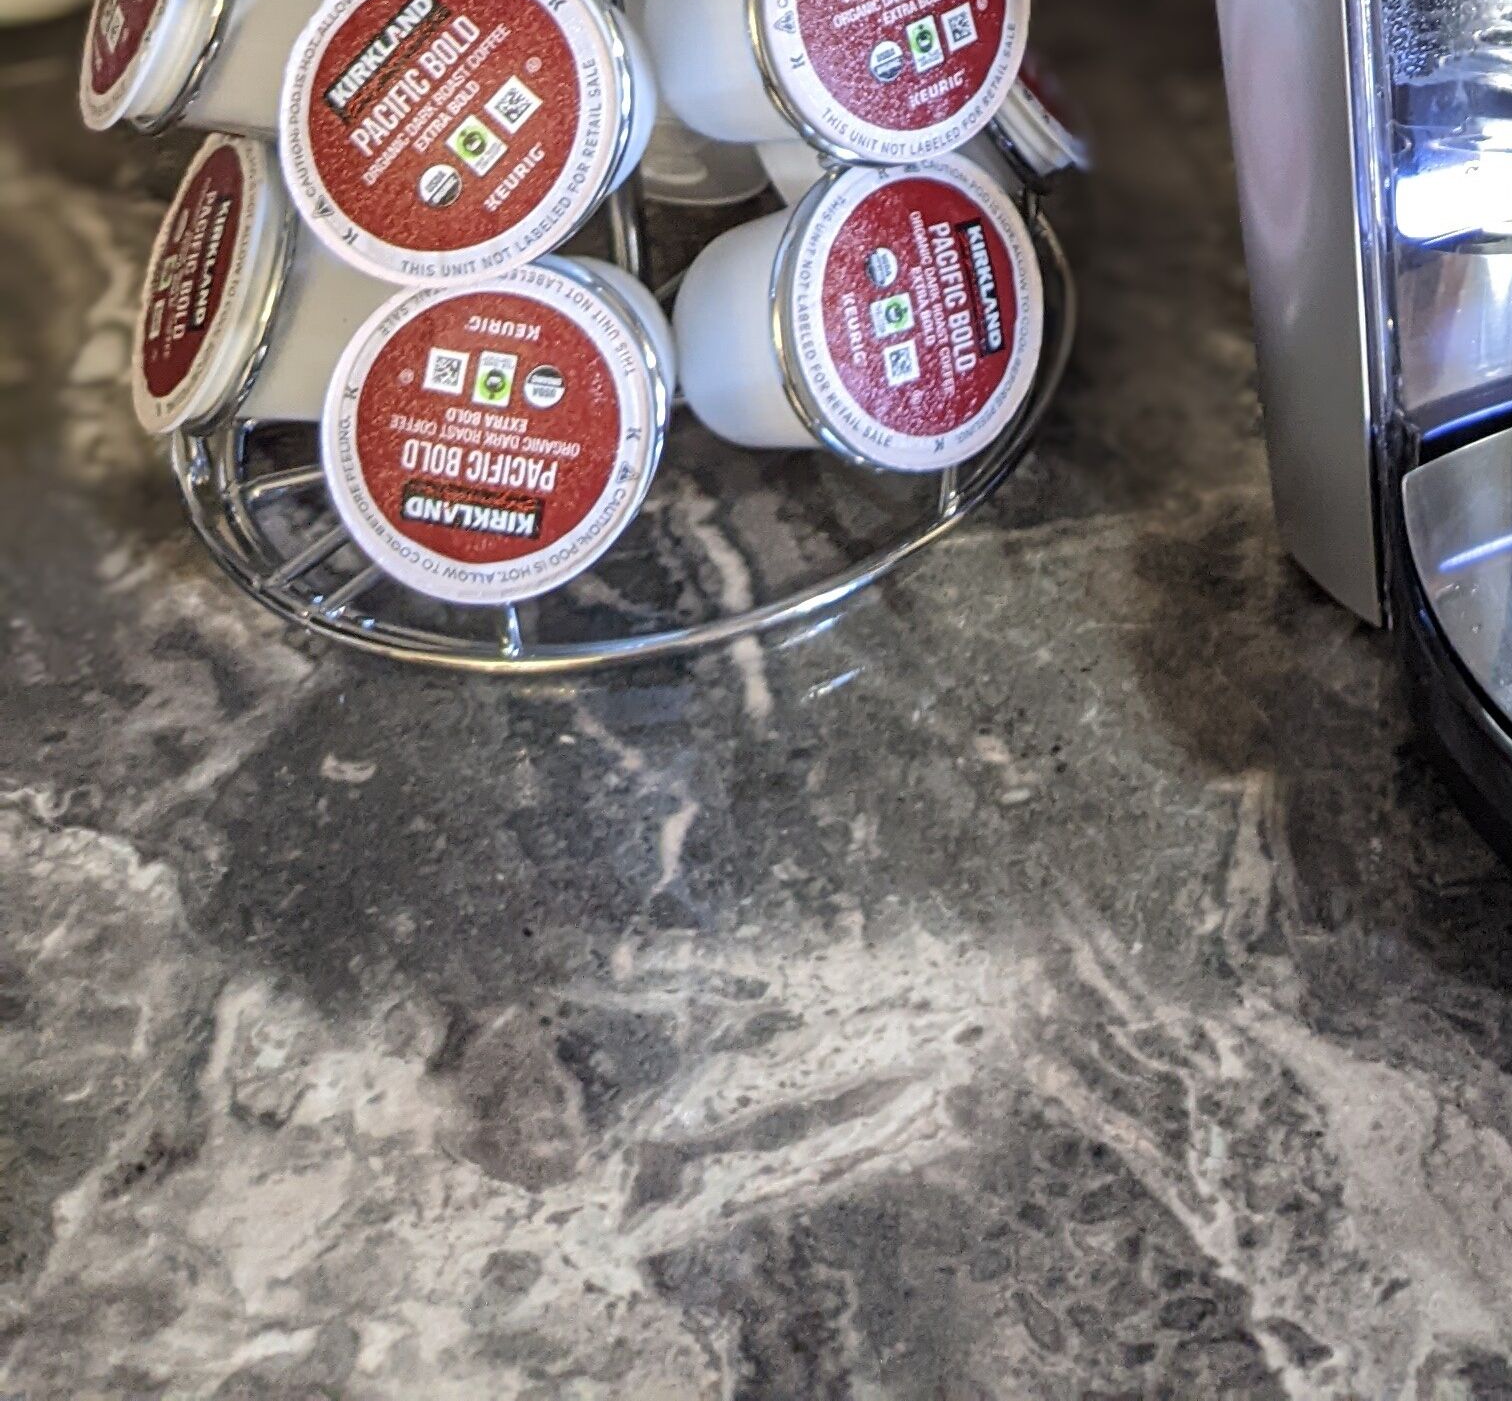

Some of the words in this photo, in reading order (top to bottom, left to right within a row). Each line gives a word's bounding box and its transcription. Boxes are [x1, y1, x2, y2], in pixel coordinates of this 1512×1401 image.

[882, 1, 918, 25] EXTRA
[431, 64, 471, 107] ROAST
[465, 22, 513, 69] COFFEE
[582, 58, 601, 99] SALE
[349, 68, 431, 157] PACIFIC
[418, 15, 481, 80] BOLD
[821, 106, 850, 134] THIS
[850, 129, 877, 150] UNIT
[881, 142, 906, 155] NOT
[909, 128, 962, 154] LABELED
[962, 108, 984, 130] FOR
[982, 63, 1008, 106] RETAIL
[1005, 23, 1016, 57] SALE
[908, 68, 966, 109] KEURIG
[413, 112, 452, 153] EXTRA
[446, 80, 481, 116] BOLD
[583, 102, 602, 158] RETAIL
[483, 142, 546, 213] KEURIG
[569, 162, 591, 193] FOR
[515, 197, 572, 252] LABELED
[194, 200, 232, 326] KIRKLAND
[400, 259, 437, 277] THIS
[440, 260, 476, 277] UNIT
[481, 247, 514, 268] NOT
[799, 259, 813, 289] NOT
[501, 268, 564, 292] LABELE
[927, 221, 967, 309] PACIFIC
[949, 309, 977, 373] BOLD
[966, 224, 1003, 351] KIRKLAND
[565, 287, 594, 312] NOT
[467, 314, 542, 341] KEURIG
[592, 310, 620, 341] UNIT
[797, 295, 817, 361] LABELED
[841, 291, 868, 368] KEURIG
[615, 342, 636, 376] THIS
[809, 363, 830, 390] FOR
[445, 407, 482, 424] BOLD
[485, 413, 529, 433] EXTRA
[826, 393, 861, 431] RETAIL
[440, 424, 482, 444] ROAST
[862, 428, 894, 447] SALE
[402, 438, 463, 477] BOLD
[465, 449, 558, 492] PACIFIC
[405, 495, 536, 535] KIRKLAND
[422, 559, 440, 575] TO
